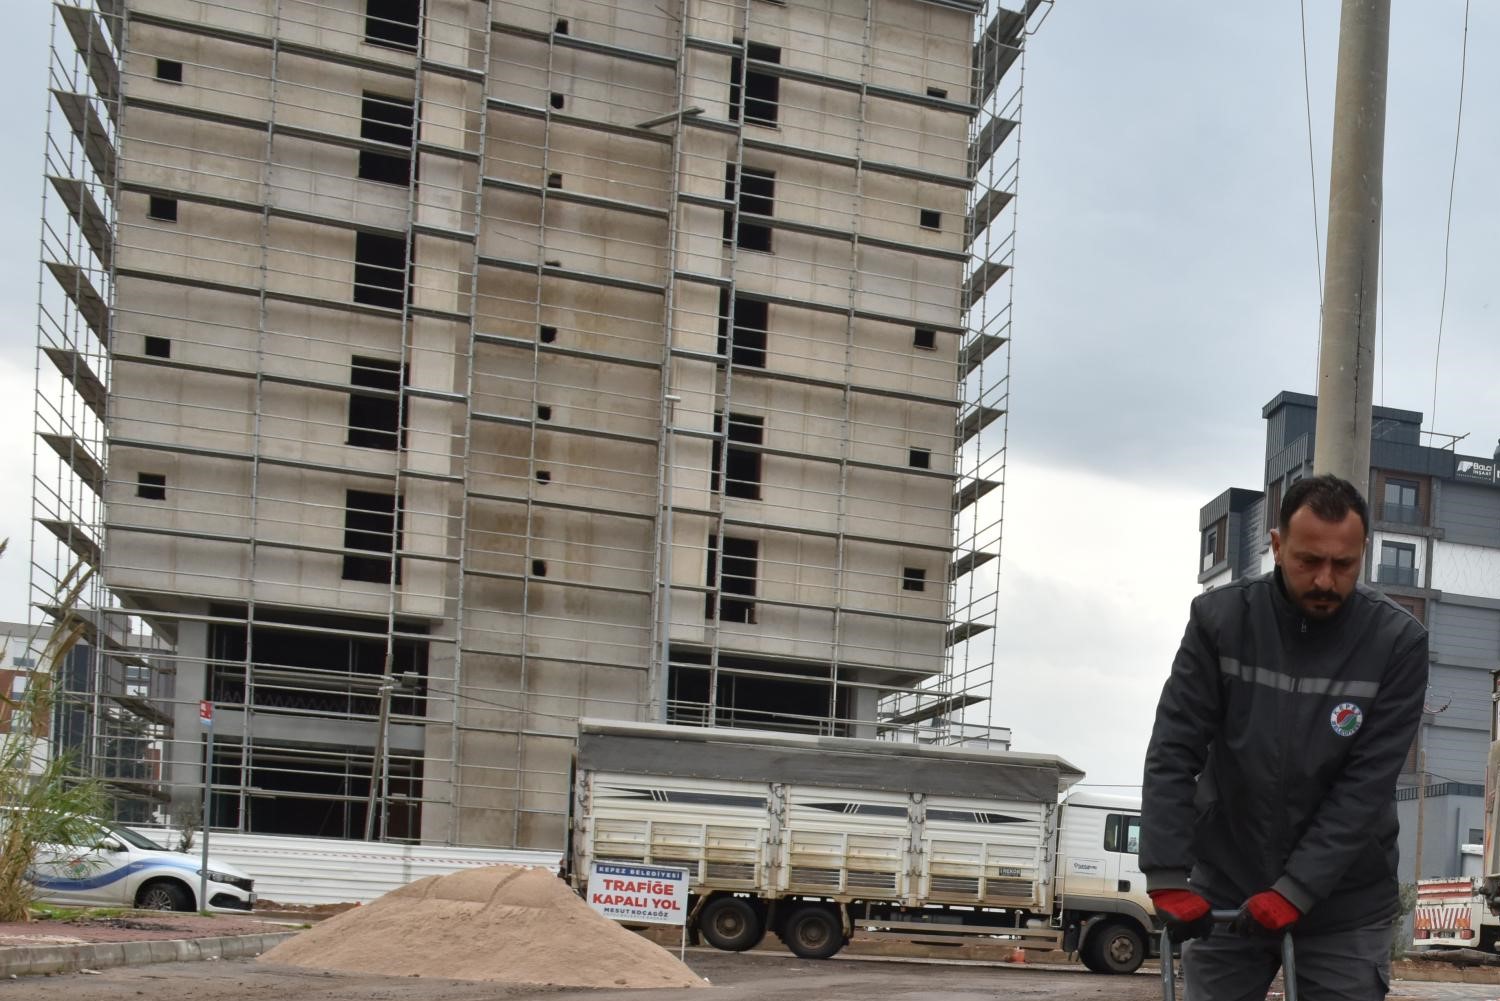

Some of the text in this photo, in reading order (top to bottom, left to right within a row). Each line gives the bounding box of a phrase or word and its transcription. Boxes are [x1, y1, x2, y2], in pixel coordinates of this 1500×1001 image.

[599, 866, 680, 879] KEPEZ BELEDİYESİ
[603, 879, 674, 896] TRAFİĞE
[592, 893, 681, 911] KAPALI YOL
[604, 907, 630, 915] MESUT
[631, 909, 669, 918] KOCAGÖZ
